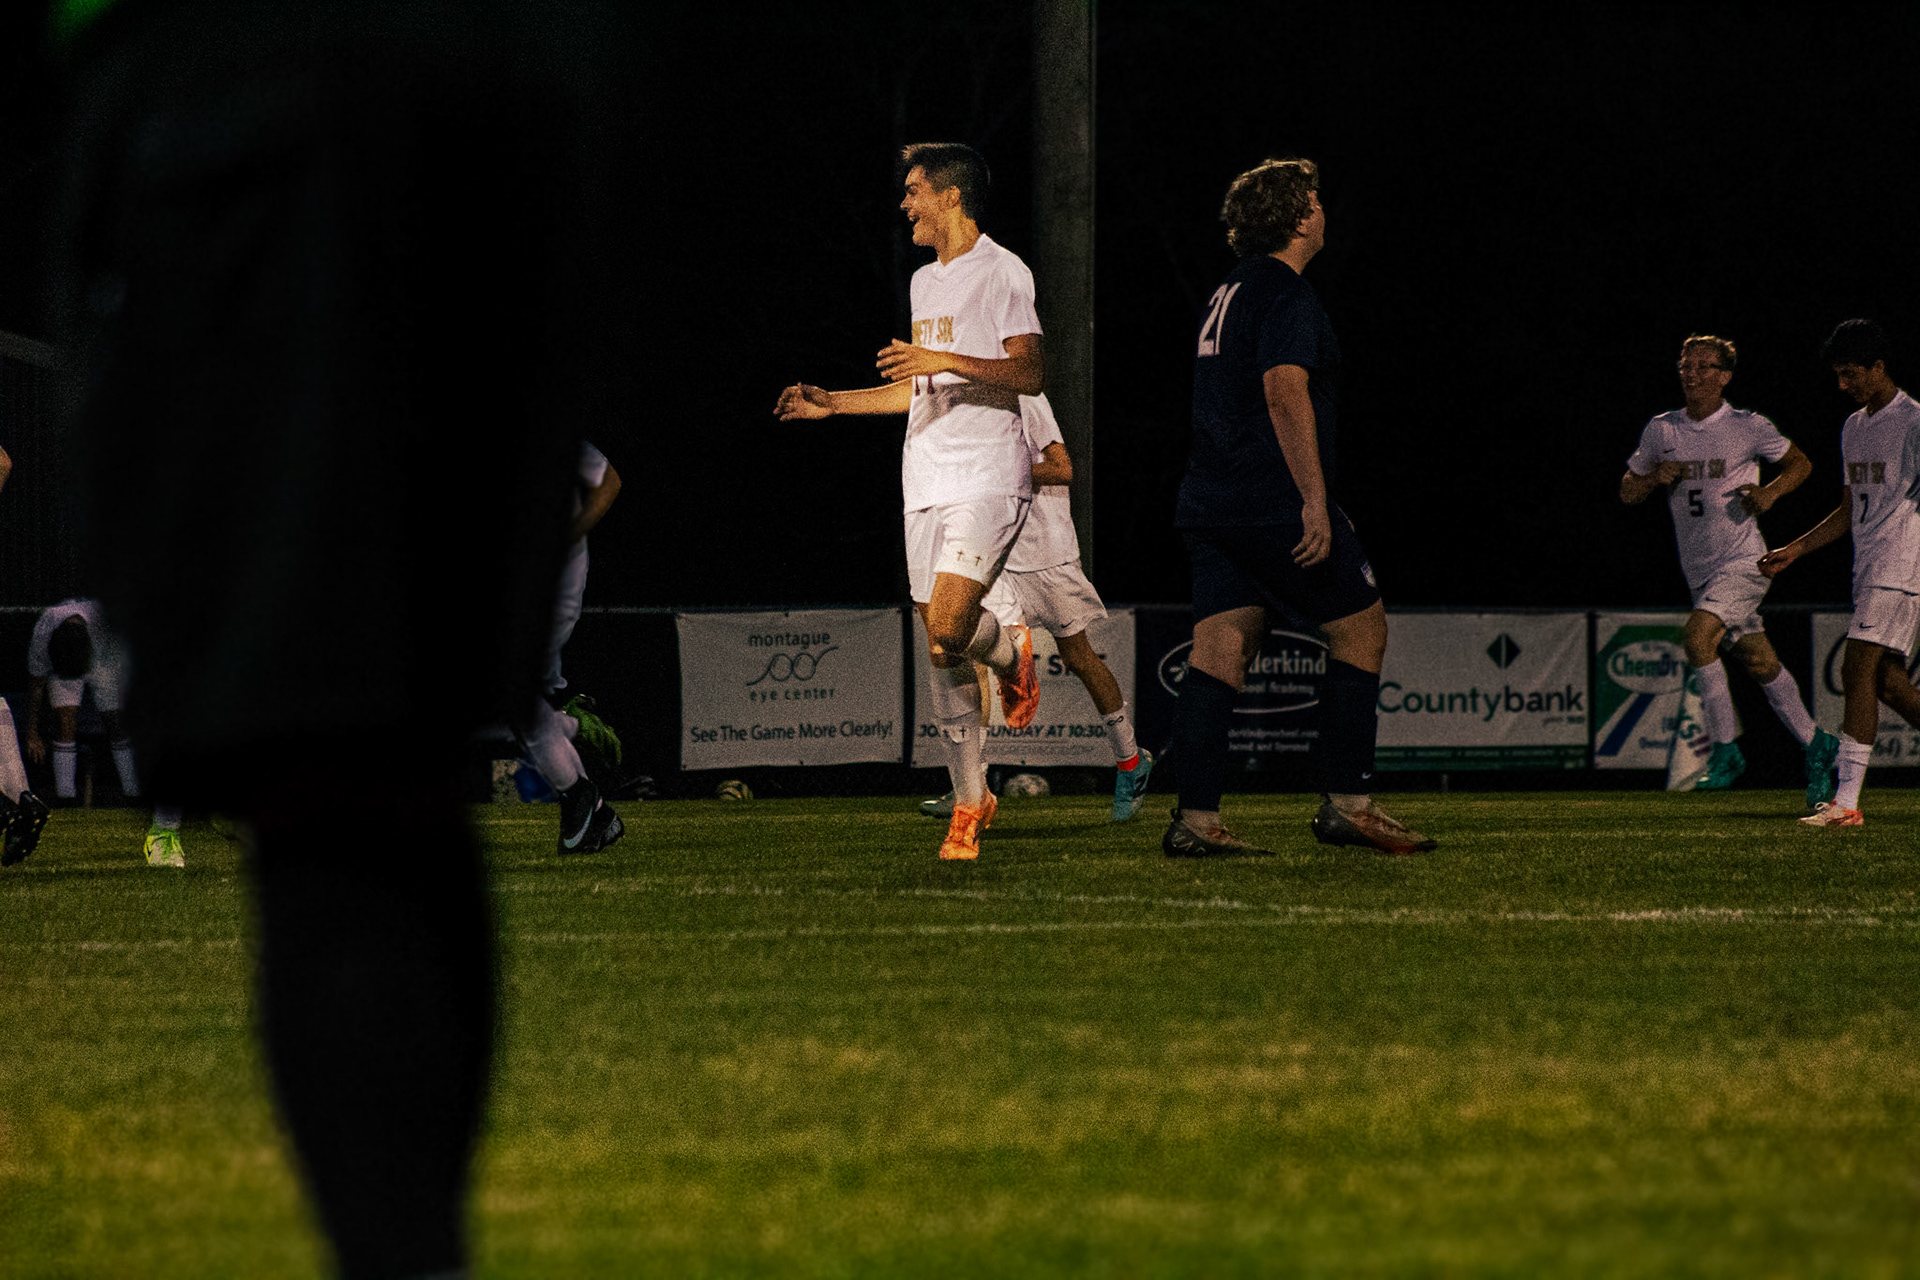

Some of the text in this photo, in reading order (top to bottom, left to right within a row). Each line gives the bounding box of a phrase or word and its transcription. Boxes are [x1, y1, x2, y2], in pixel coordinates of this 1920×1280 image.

[1197, 281, 1242, 358] 21
[1689, 490, 1703, 516] 5
[748, 632, 831, 649] montague
[1248, 650, 1326, 675] derkind
[1612, 652, 1679, 677] ChemDr
[750, 687, 836, 702] eye center
[1377, 681, 1584, 722] Countybank
[690, 720, 894, 742] See The Game More Clearly!
[1047, 725, 1064, 738] AT
